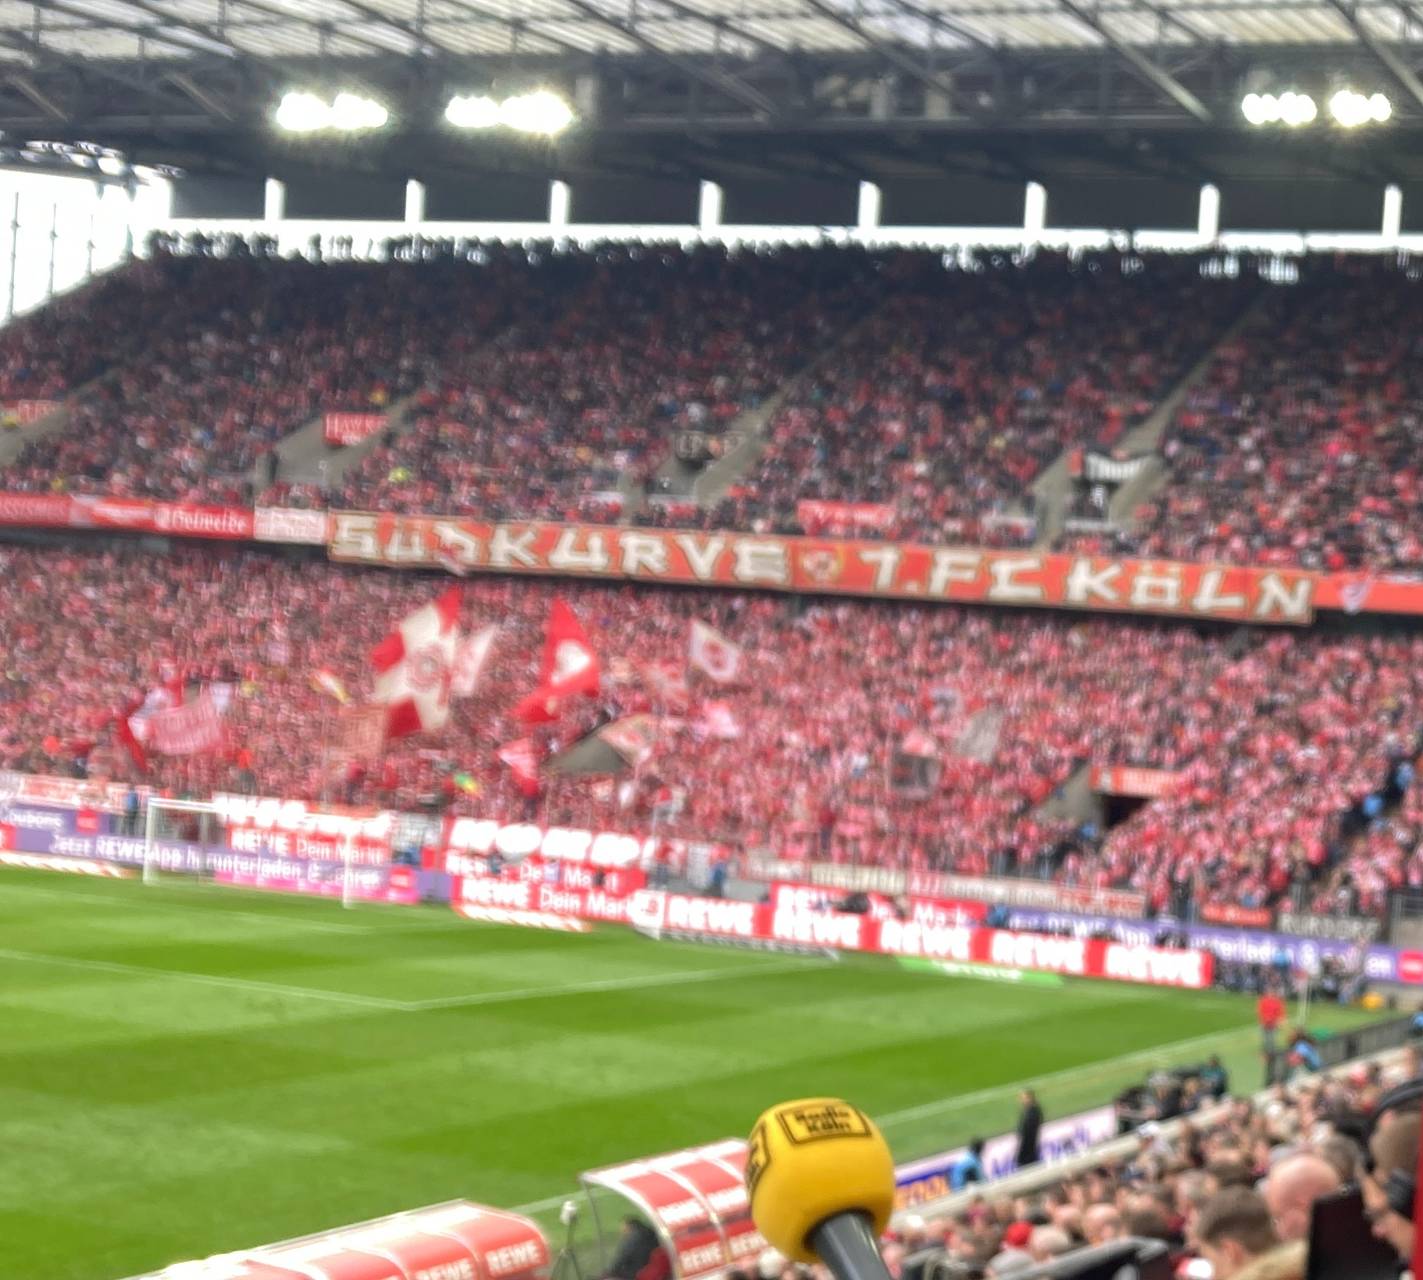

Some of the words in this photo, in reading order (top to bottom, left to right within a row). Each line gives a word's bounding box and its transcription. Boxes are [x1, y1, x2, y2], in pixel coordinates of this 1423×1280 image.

[1065, 555, 1313, 618] KÖLN
[669, 897, 752, 934] REWE
[775, 907, 859, 946] REWE
[881, 919, 968, 958] REWE
[992, 932, 1083, 971] REWE
[1107, 945, 1200, 984] REWE
[485, 1240, 541, 1275] REWE
